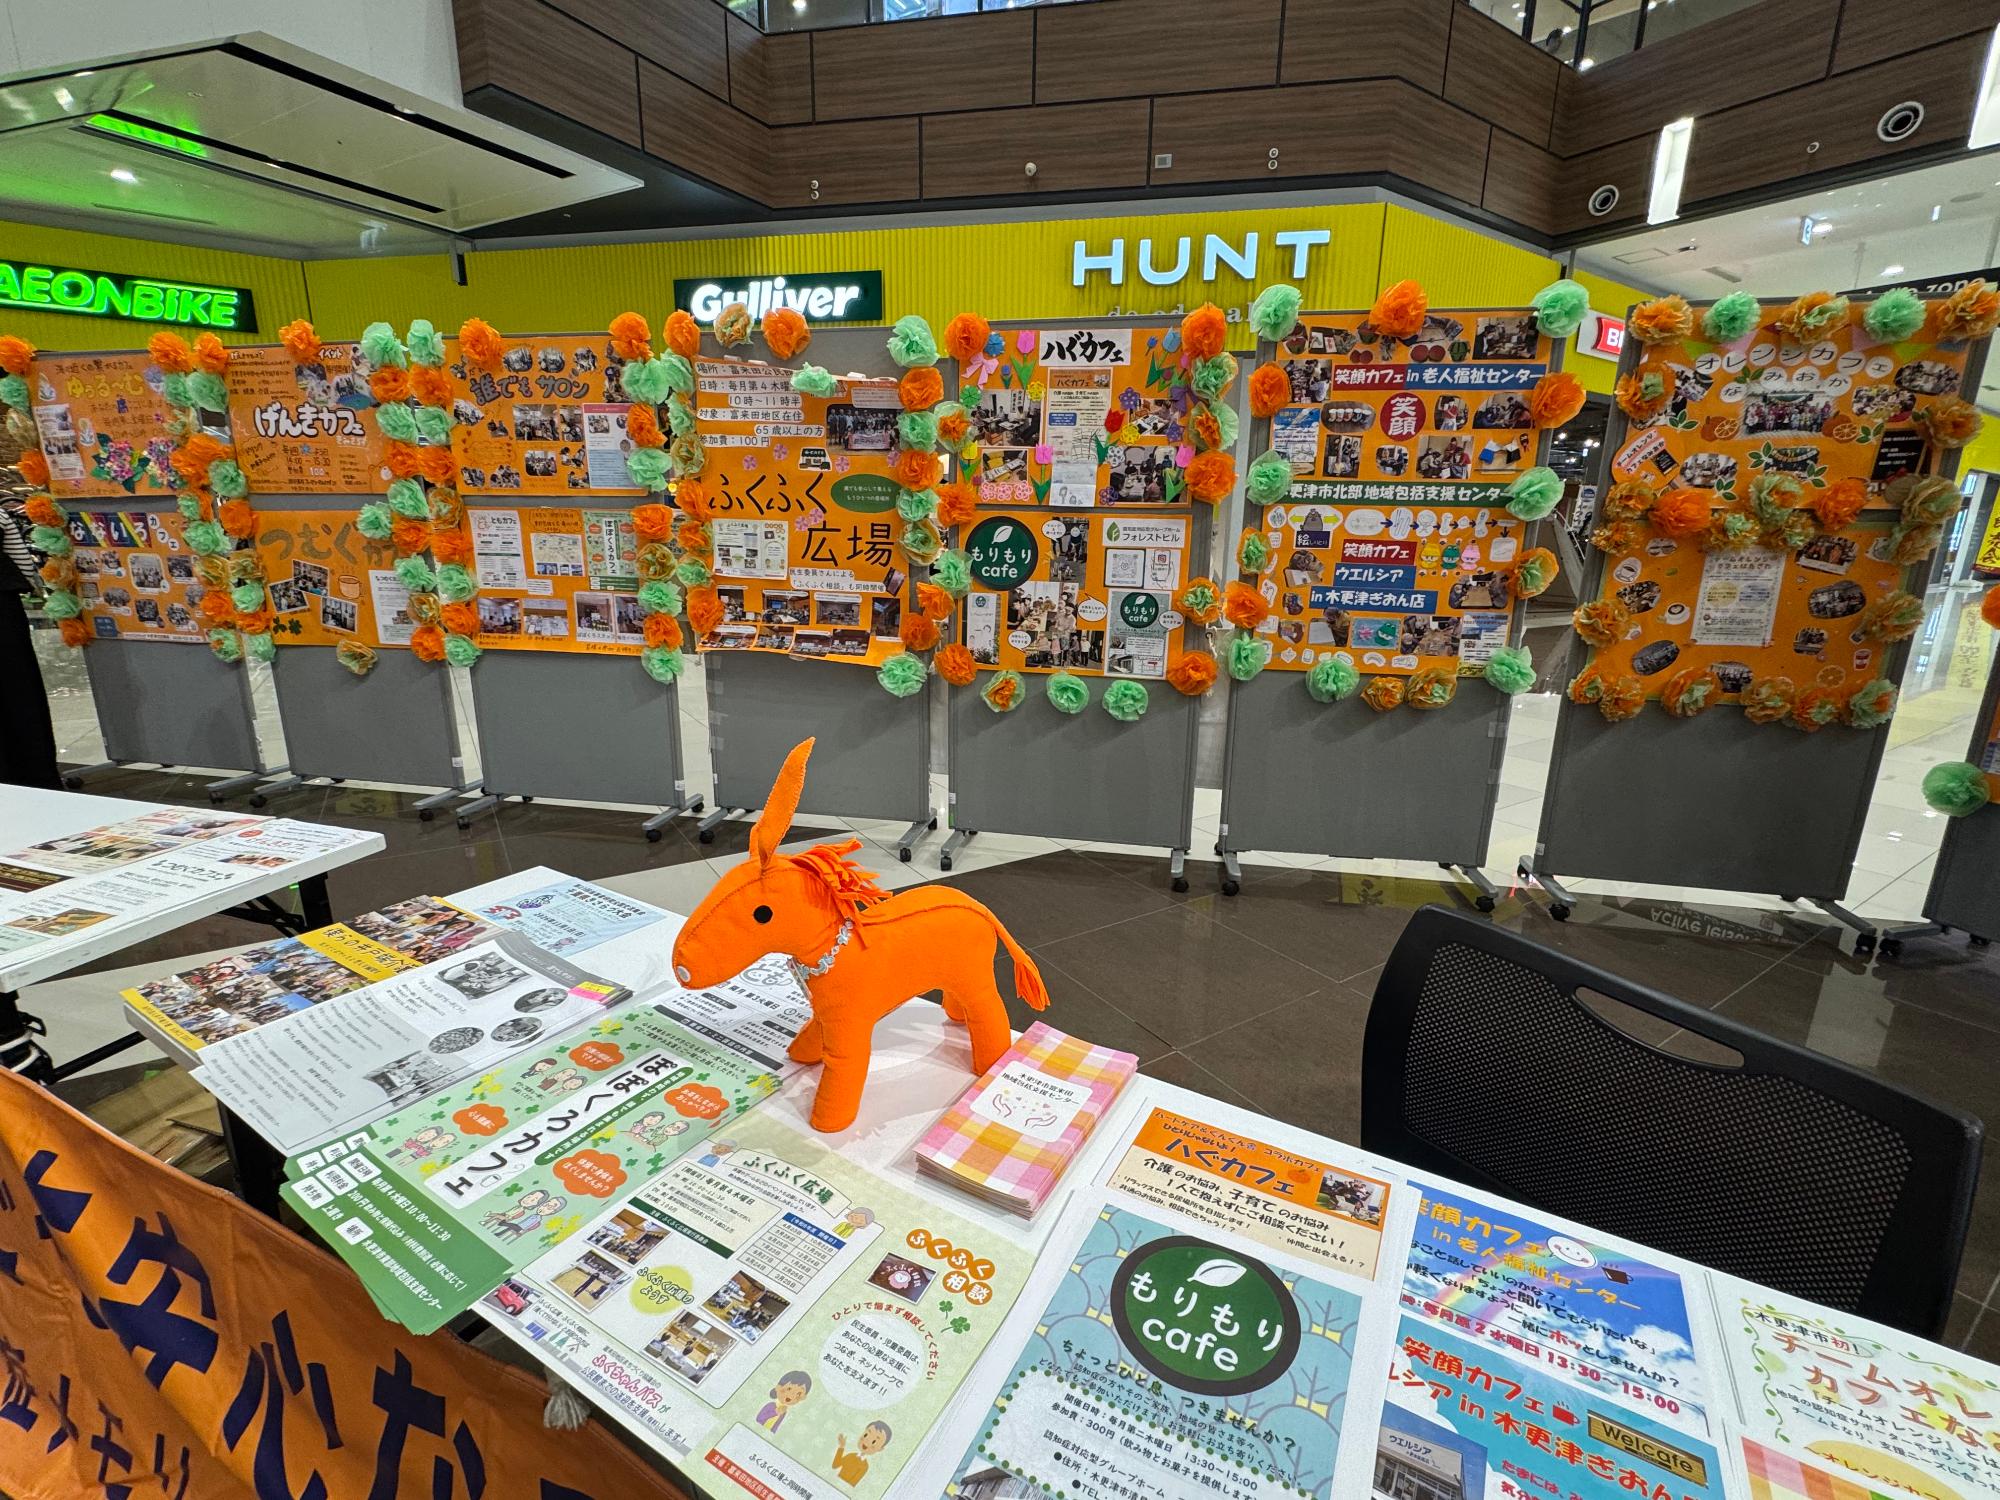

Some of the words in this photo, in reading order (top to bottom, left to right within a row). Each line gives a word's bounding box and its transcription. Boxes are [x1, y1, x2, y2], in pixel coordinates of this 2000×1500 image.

[1073, 230, 1331, 287] HUNT
[691, 274, 861, 322] Gulliver
[1041, 330, 1125, 363] ハぐカフェ
[470, 372, 533, 406] 誰でも
[535, 374, 590, 399] サロン
[1334, 368, 1404, 385] 笑顔カフェ
[1406, 369, 1420, 382] in
[1422, 366, 1546, 384] 老人福祉センター
[254, 401, 366, 438] げんきカフェ
[756, 426, 823, 437] 65歳以上の方
[1388, 396, 1420, 437] 笑顔
[709, 473, 828, 515] ふくふく
[1284, 482, 1514, 503] 更津市北部地域包括支援センター
[69, 520, 149, 542] なないろ
[490, 515, 517, 526] ともカフェ
[801, 520, 895, 568] 広場
[1122, 533, 1180, 543] フォレストヒル
[1344, 542, 1410, 560] 笑顔カフェ
[971, 546, 1032, 564] もりもり
[981, 564, 1018, 578] cafe
[1335, 567, 1404, 583] ウエルシア
[1124, 605, 1156, 614] もりもり
[1310, 590, 1323, 603] in
[1325, 589, 1426, 609] 木更津ぎおん店
[1128, 614, 1149, 623] cafe
[1001, 1072, 1080, 1105] 地域包括支援センター
[1019, 1073, 1074, 1097] 木更津市富来田
[444, 1054, 678, 1198] ぽぽくろカフェ
[1162, 1122, 1237, 1153] ひとりじゃないよ！
[1165, 1138, 1296, 1196] ハぐカフェ
[1263, 1147, 1321, 1174] コラボカフェ
[325, 1169, 350, 1190] 利用料金
[743, 1156, 834, 1206] ふくふく広場
[345, 1224, 362, 1238] 場所
[909, 1233, 991, 1278] ふくふく
[1431, 1225, 1451, 1243] in
[1456, 1236, 1641, 1311] 老人福祉センター
[637, 1267, 695, 1305] ふくふく広場の
[640, 1285, 670, 1305] ようす
[947, 1272, 991, 1304] 相談
[1129, 1270, 1284, 1353] もりもり
[832, 1301, 939, 1381] ひとりで悩まず相談してください
[1141, 1316, 1240, 1375] cafe
[1754, 1311, 1860, 1356] 木更津市初！
[833, 1341, 904, 1389] つなぎ、ネットワークで
[841, 1330, 911, 1375] あなたの必要な支援に
[1506, 1316, 1680, 1389] 一緒にホッとしませんか？
[1401, 1335, 1546, 1416] 笑顔カフェ
[657, 1404, 671, 1415] が
[1063, 1393, 1174, 1453] 開催日時：毎月第二木曜日
[1458, 1396, 1487, 1420] in
[1042, 1428, 1165, 1499] 認知症対応型グループホーム
[1600, 1420, 1694, 1475] Welcafe
